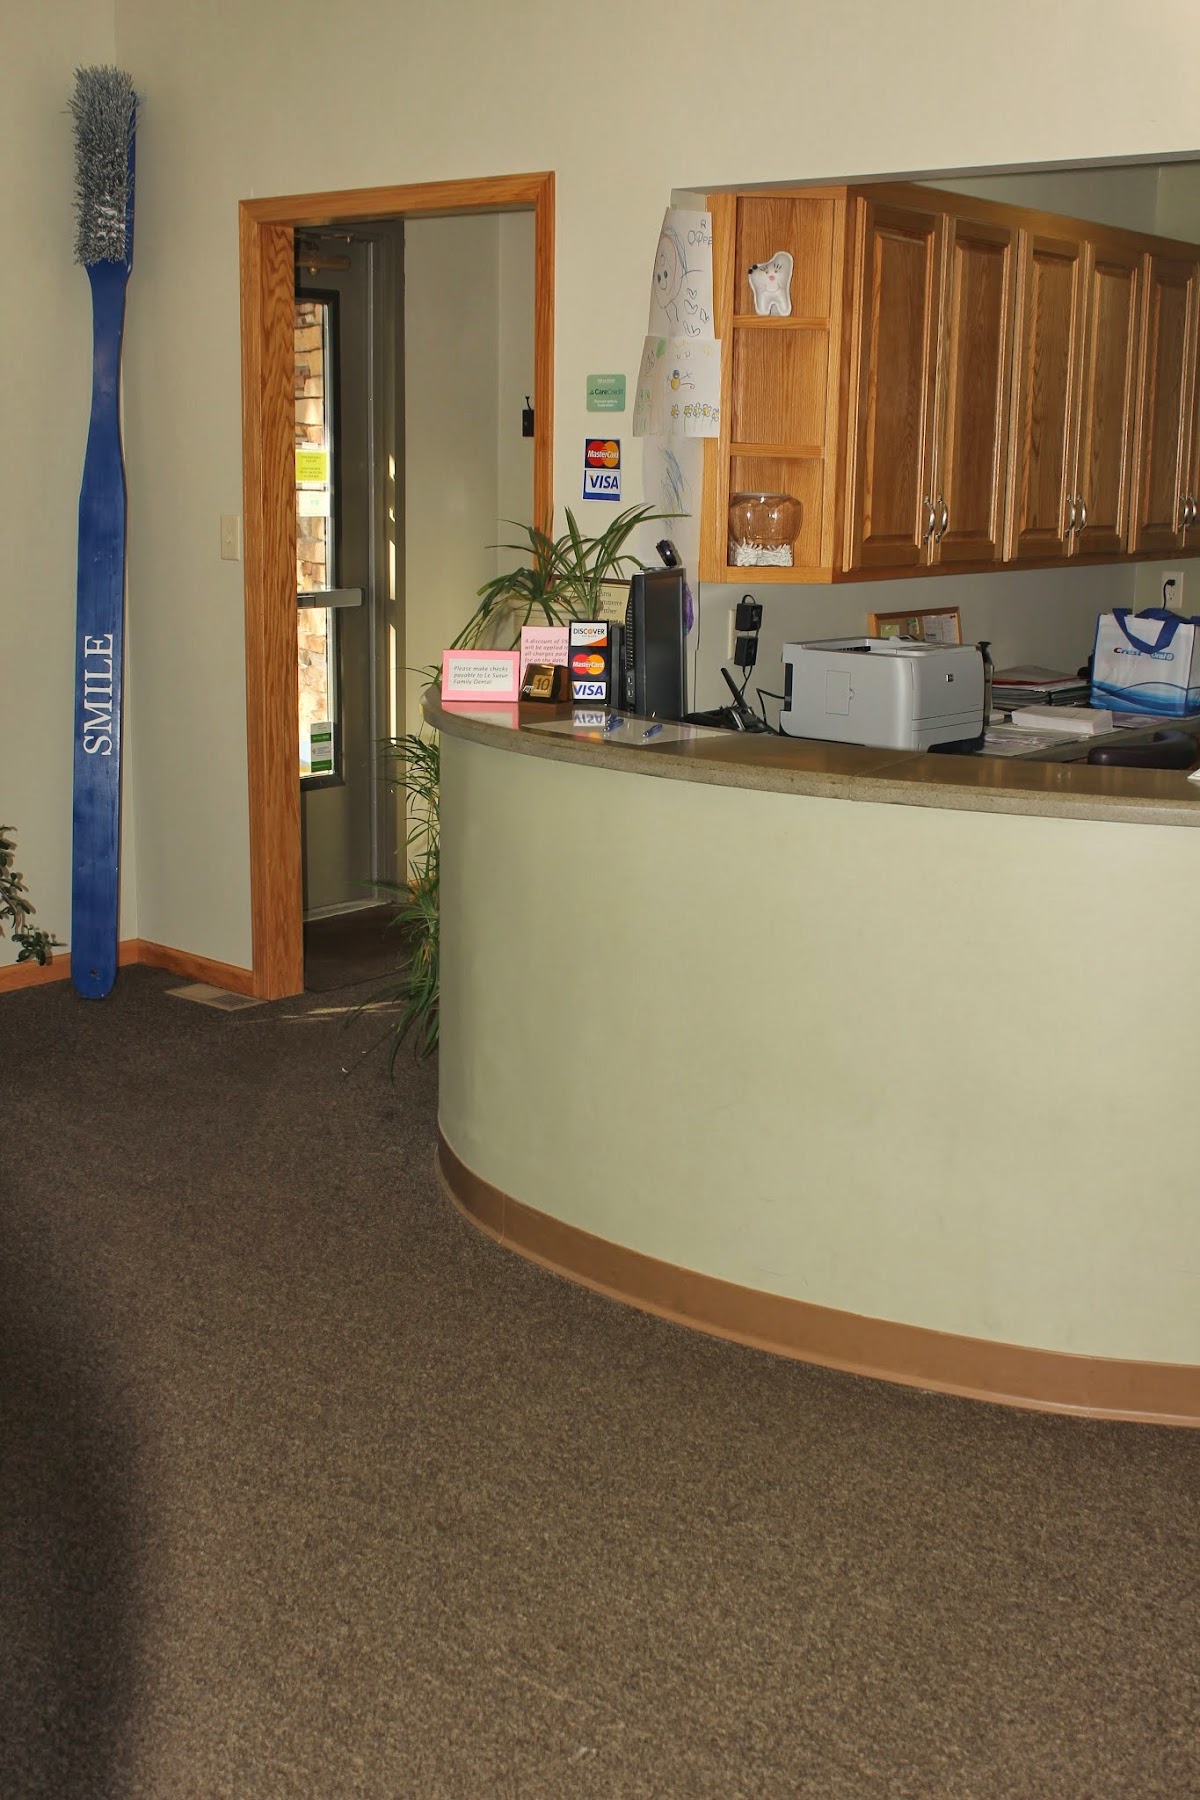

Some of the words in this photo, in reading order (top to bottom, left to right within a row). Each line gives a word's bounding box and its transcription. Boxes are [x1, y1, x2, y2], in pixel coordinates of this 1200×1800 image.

[587, 450, 619, 459] MasterCard
[588, 474, 619, 490] VISA
[1113, 647, 1142, 656] Crest
[535, 677, 551, 691] 10
[572, 684, 604, 696] VISA
[83, 633, 113, 756] SMILE
